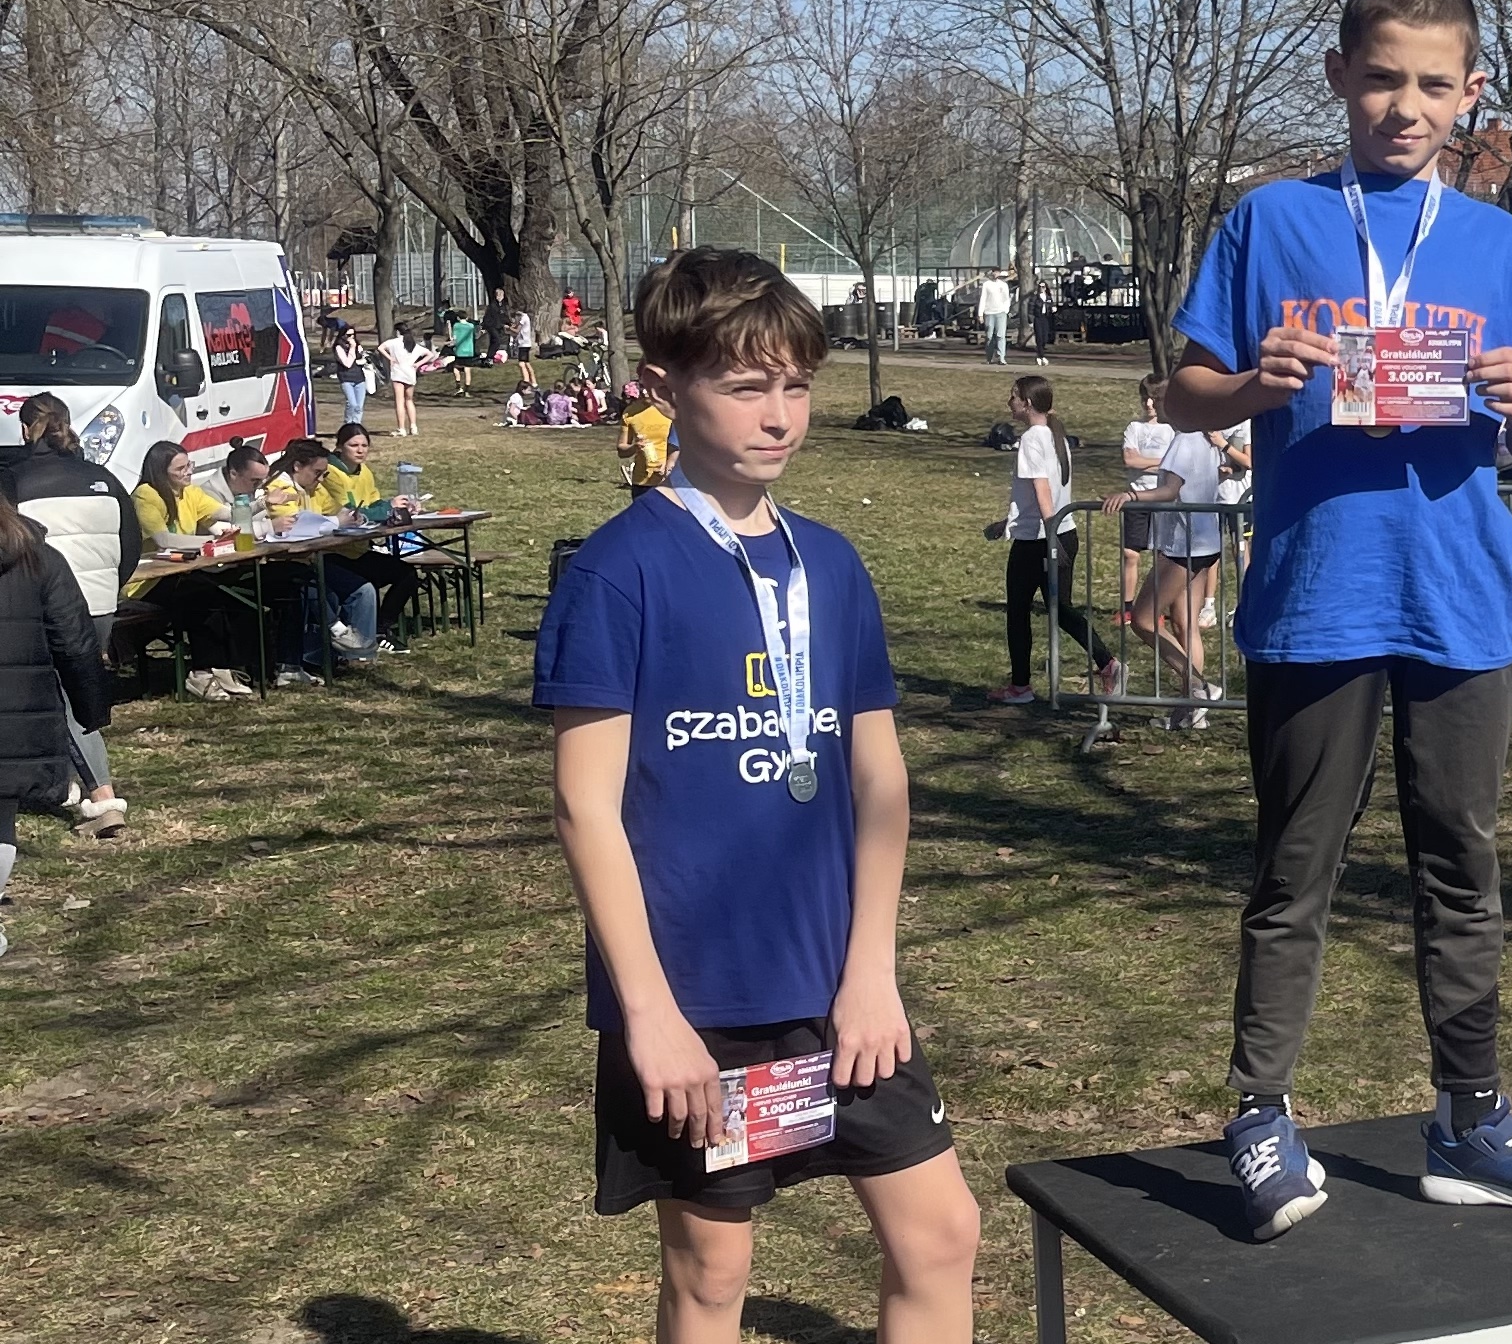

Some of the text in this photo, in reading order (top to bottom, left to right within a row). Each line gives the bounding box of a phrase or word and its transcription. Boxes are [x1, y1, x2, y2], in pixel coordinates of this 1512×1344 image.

[1281, 297, 1487, 356] KOSUTH
[1388, 372, 1424, 382] 3.000
[1425, 371, 1441, 382] FT
[759, 1100, 795, 1117] 3.000
[796, 1097, 811, 1109] FT
